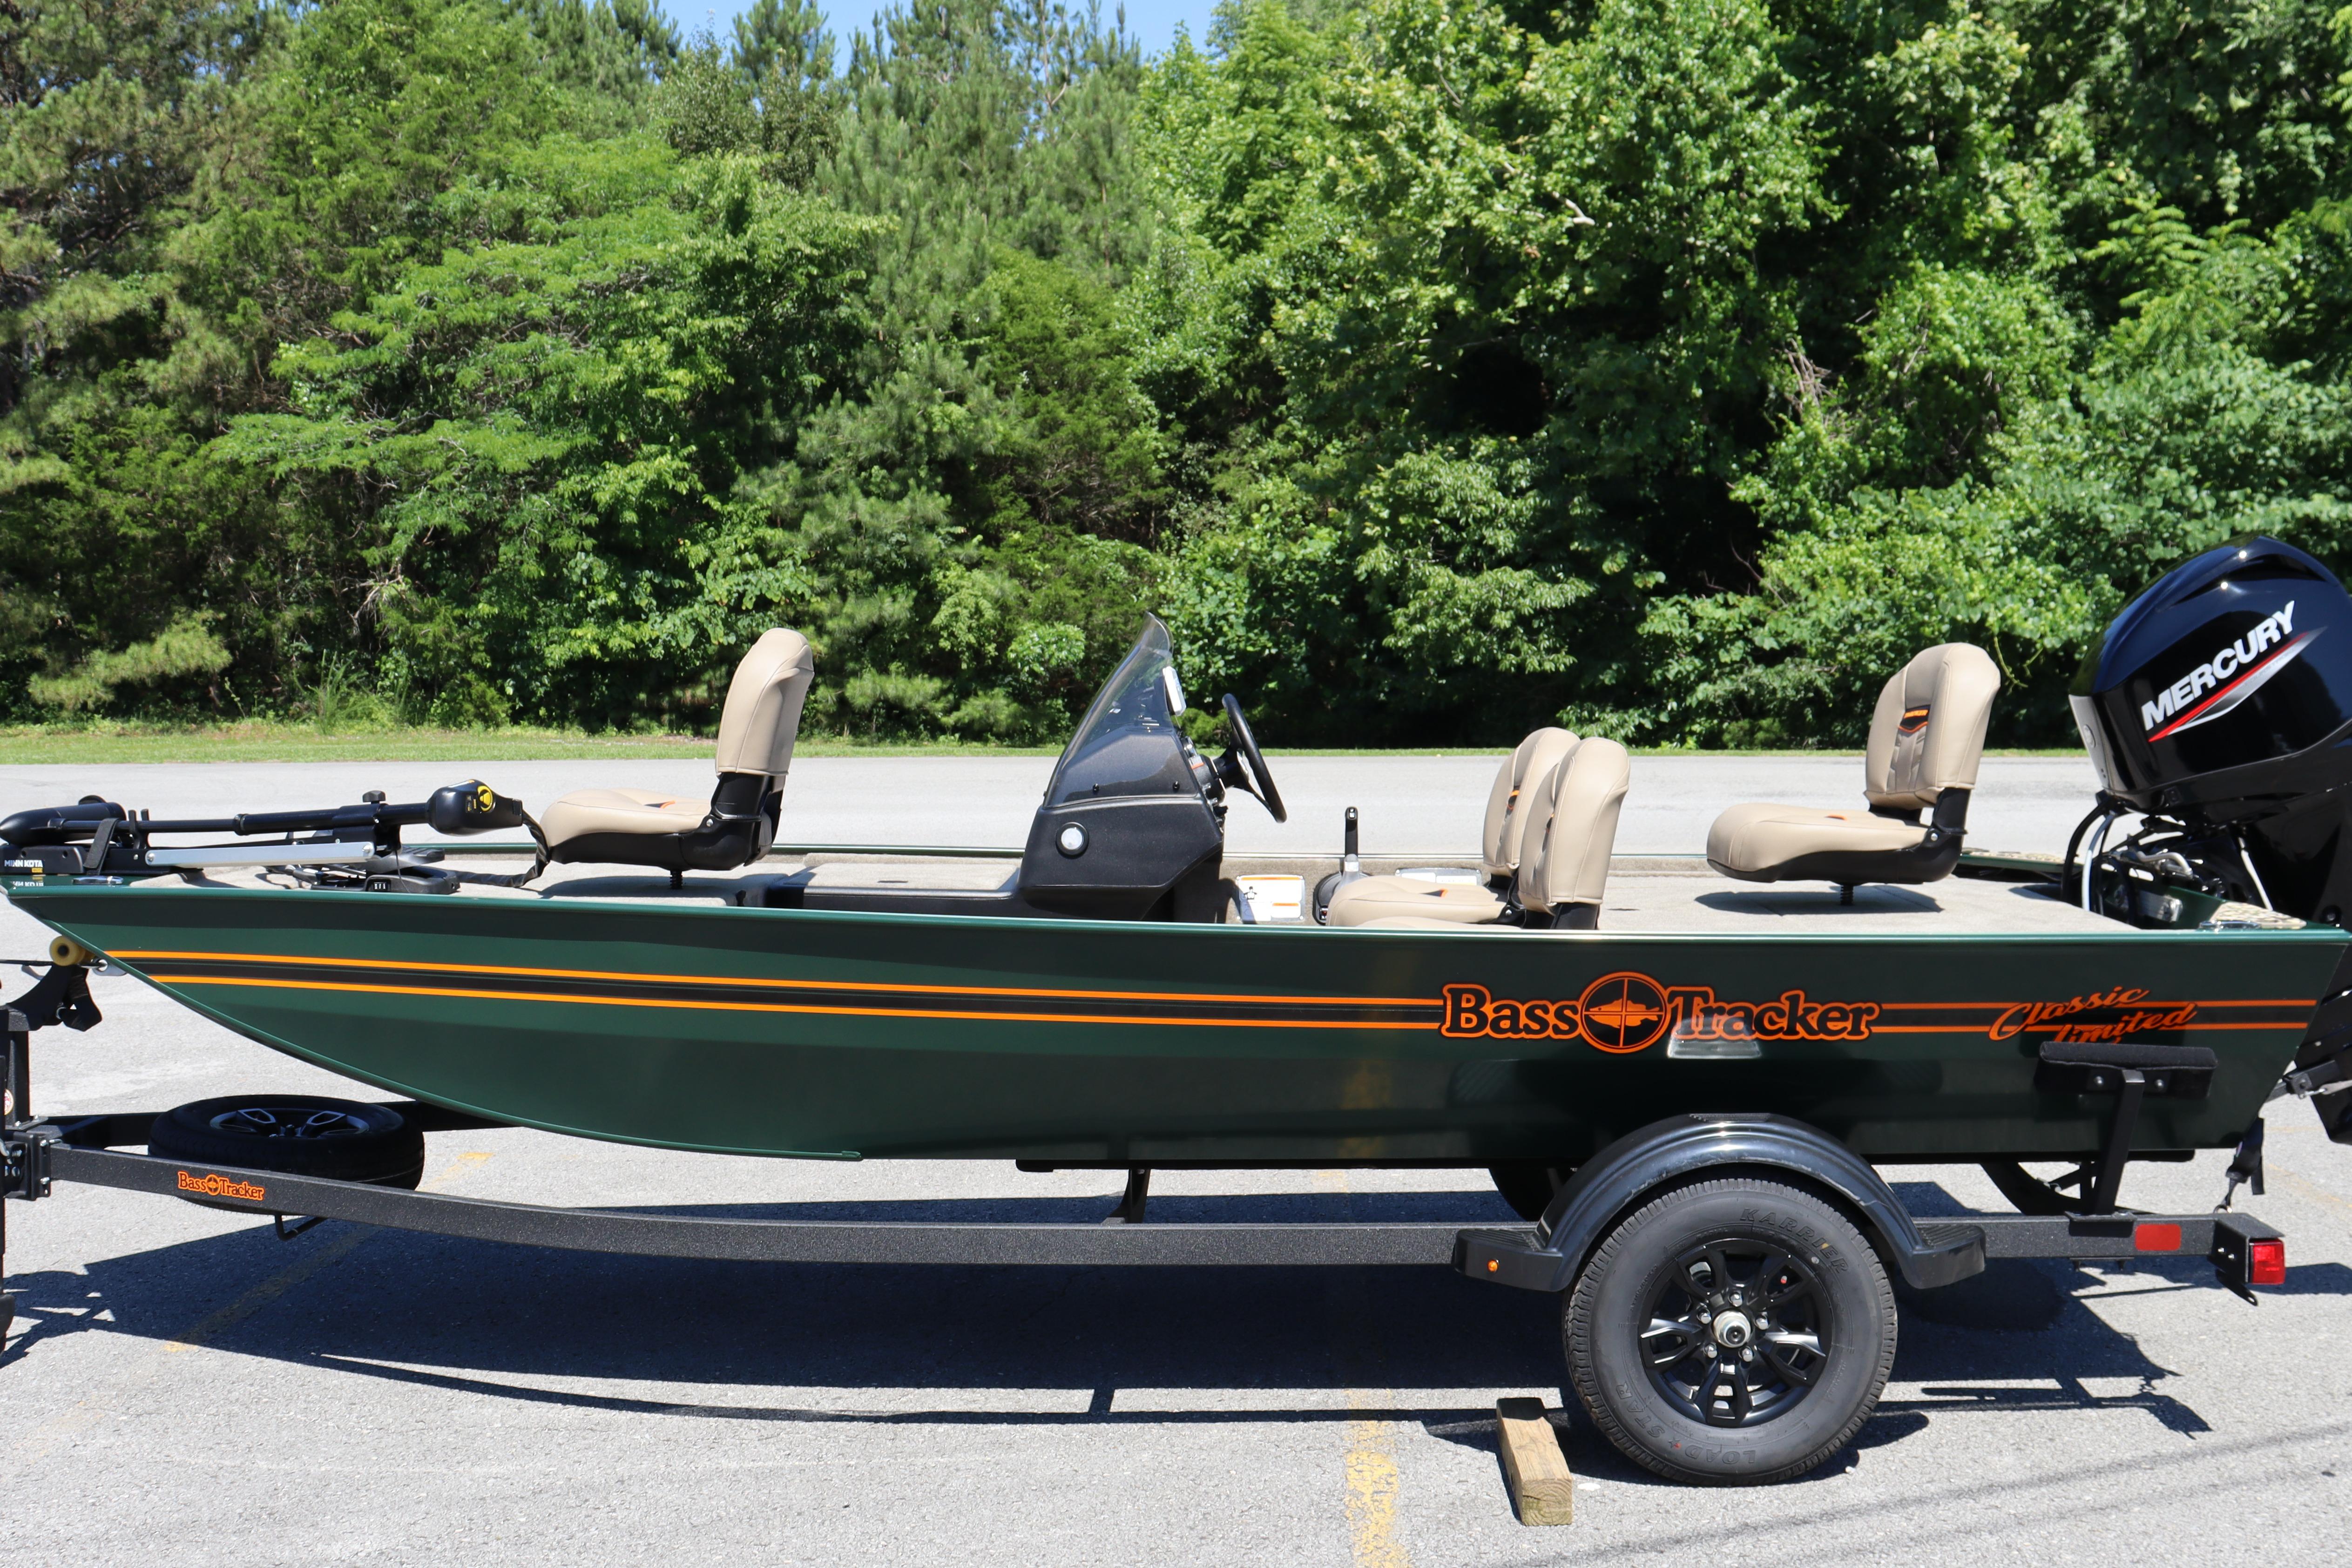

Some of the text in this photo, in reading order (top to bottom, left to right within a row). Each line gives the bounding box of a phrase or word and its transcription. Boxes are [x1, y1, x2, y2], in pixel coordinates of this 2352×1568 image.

[2141, 600, 2295, 731] MERCURY
[1441, 983, 1880, 1041] Bass Tracker
[1989, 986, 2150, 1041] Classic
[178, 1170, 265, 1201] Bass Tracker
[1739, 1208, 1850, 1274] KARRIER
[1615, 1381, 1757, 1465] LOAD STAR
